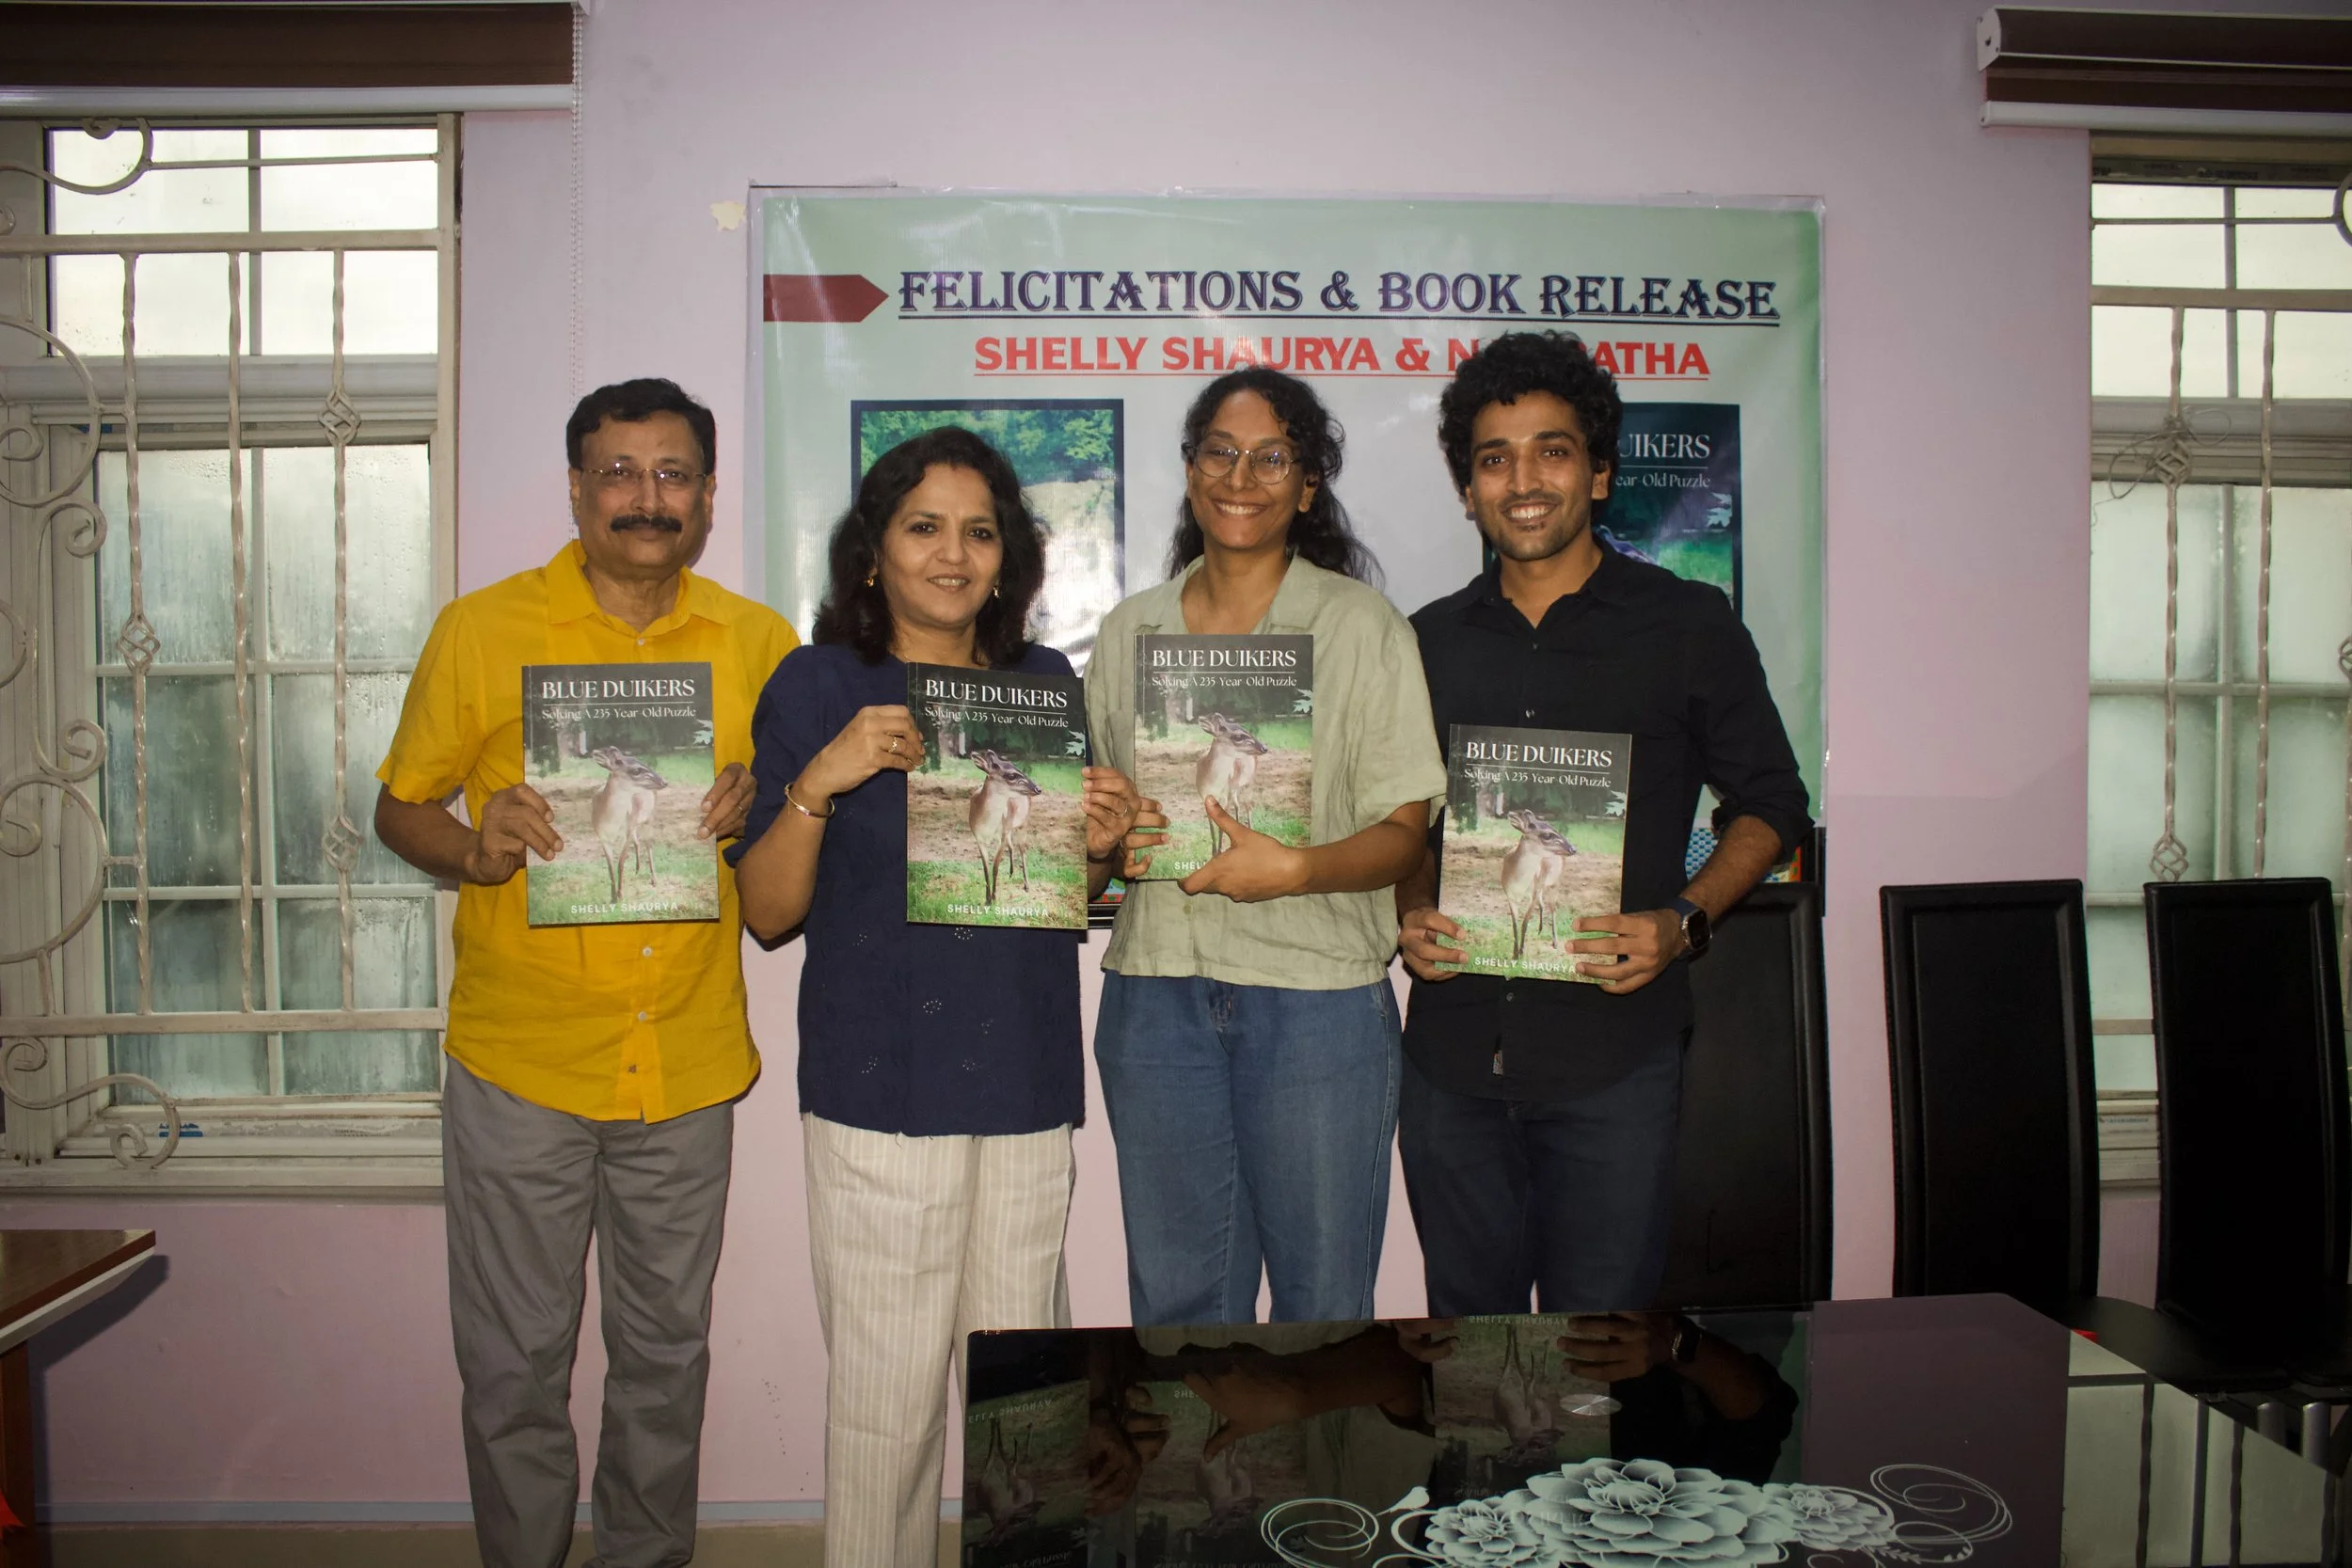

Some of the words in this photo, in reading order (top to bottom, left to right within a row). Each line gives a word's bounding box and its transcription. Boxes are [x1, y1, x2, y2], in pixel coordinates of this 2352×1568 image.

[898, 269, 1304, 313] FELICITATIONS
[1320, 270, 1359, 312] &
[1377, 271, 1522, 314] BOOK
[1539, 274, 1780, 320] RELEASE
[974, 336, 1150, 372] SHELLY
[1162, 337, 1381, 372] SHAURYA
[1395, 337, 1430, 372] &
[1447, 337, 1710, 375] NATHA
[1669, 473, 1711, 488] Puzzle
[1152, 649, 1205, 668] BLUE
[1209, 649, 1297, 668] DUIKERS
[542, 680, 598, 699] BLUE
[602, 678, 695, 699] DUIKERS
[1266, 675, 1297, 687] Puzzle
[926, 678, 977, 702] BLUE
[981, 684, 1068, 708] DUIKERS
[663, 705, 697, 718] Puzzle
[1038, 716, 1070, 728] Puzzle
[1466, 741, 1518, 762] BLUE
[1522, 744, 1613, 768] DUIKERS
[1579, 776, 1612, 788] Puzzle
[1174, 861, 1206, 870] SHEL
[570, 903, 617, 914] SHELLY
[621, 901, 678, 912] SHAURYA
[947, 903, 991, 915] SHELLY
[994, 905, 1049, 917] SHAURYA
[1474, 956, 1518, 968] SHELLY
[1521, 960, 1577, 973] SHAURYA
